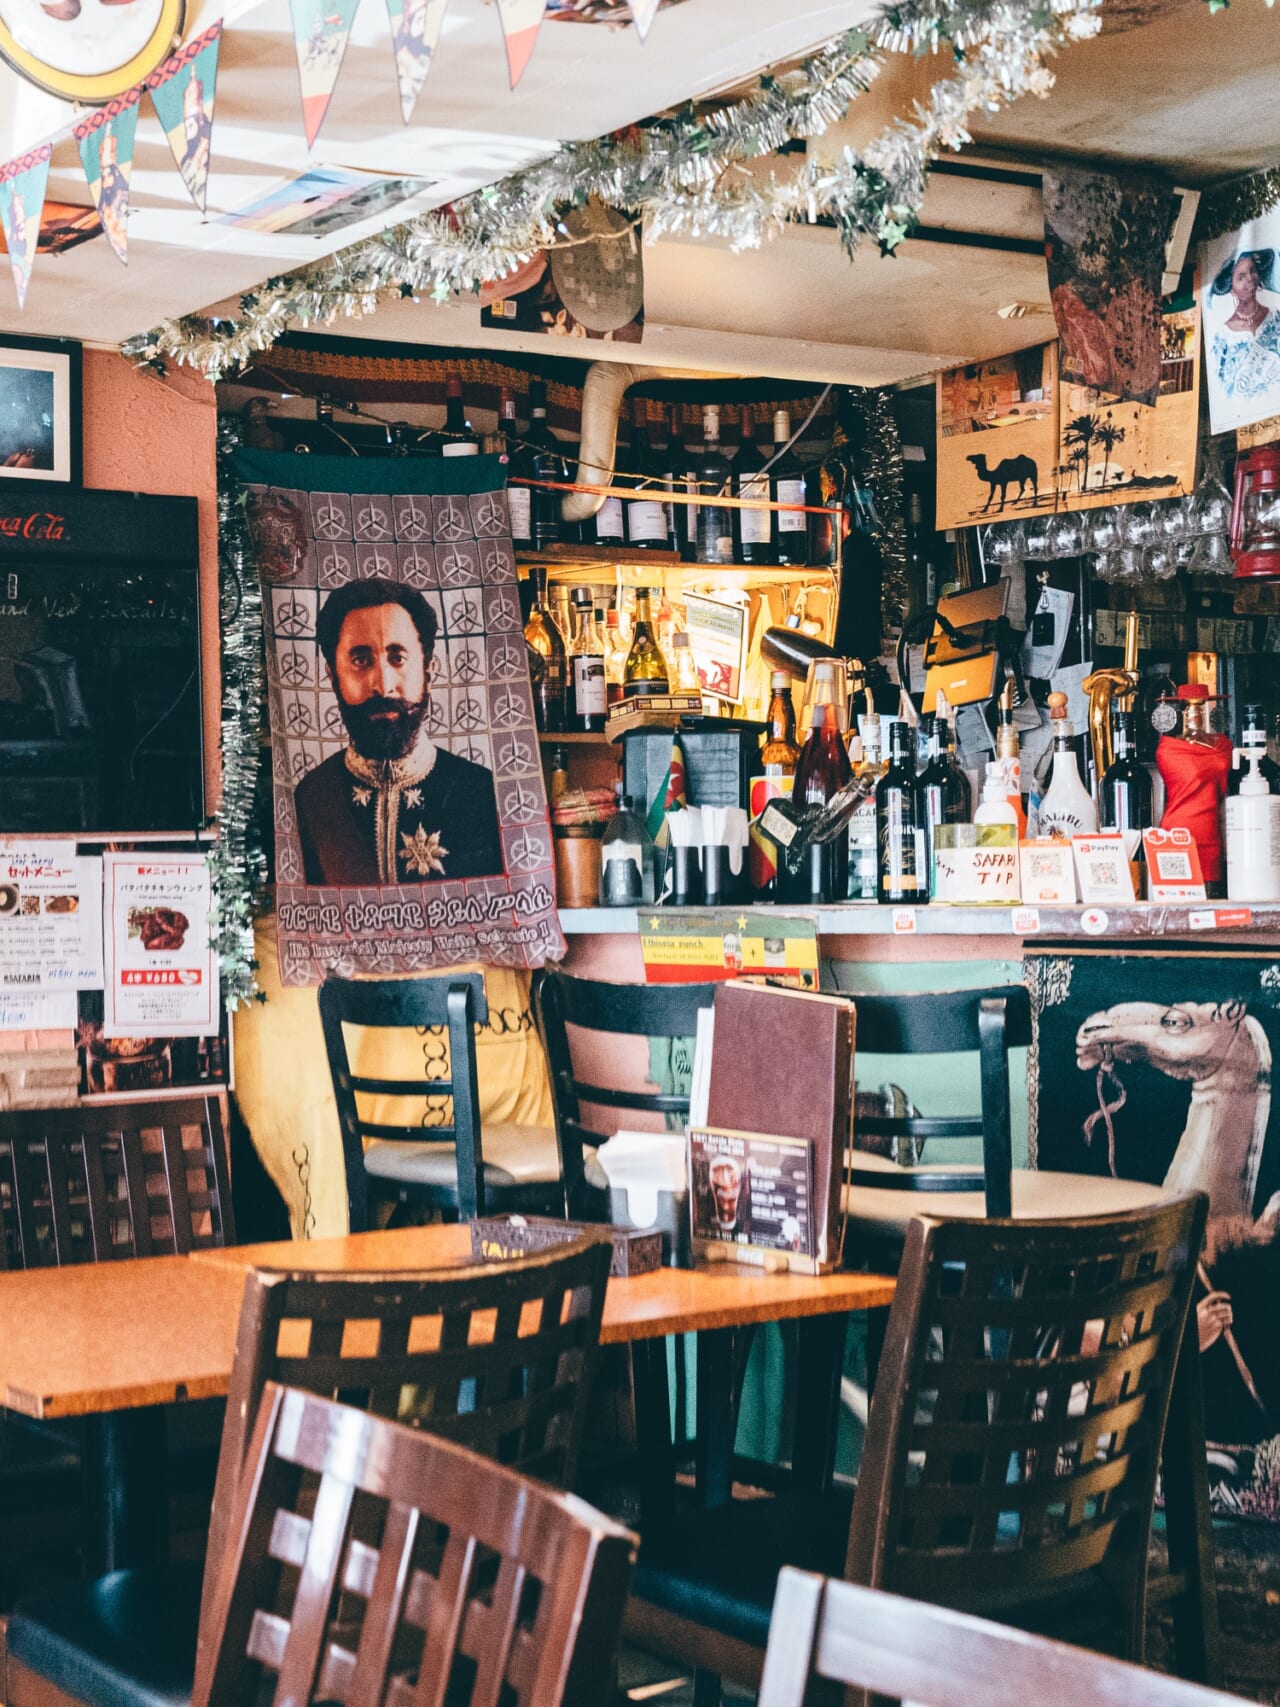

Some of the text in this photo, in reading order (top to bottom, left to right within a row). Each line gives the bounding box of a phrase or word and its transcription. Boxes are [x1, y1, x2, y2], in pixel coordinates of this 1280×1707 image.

[1037, 813, 1084, 830] MALIBU
[1092, 844, 1119, 852] PayPay
[973, 853, 1016, 868] SAFARI
[8, 866, 73, 879] セットメニュー
[434, 934, 477, 950] Haile
[678, 939, 704, 949] punch
